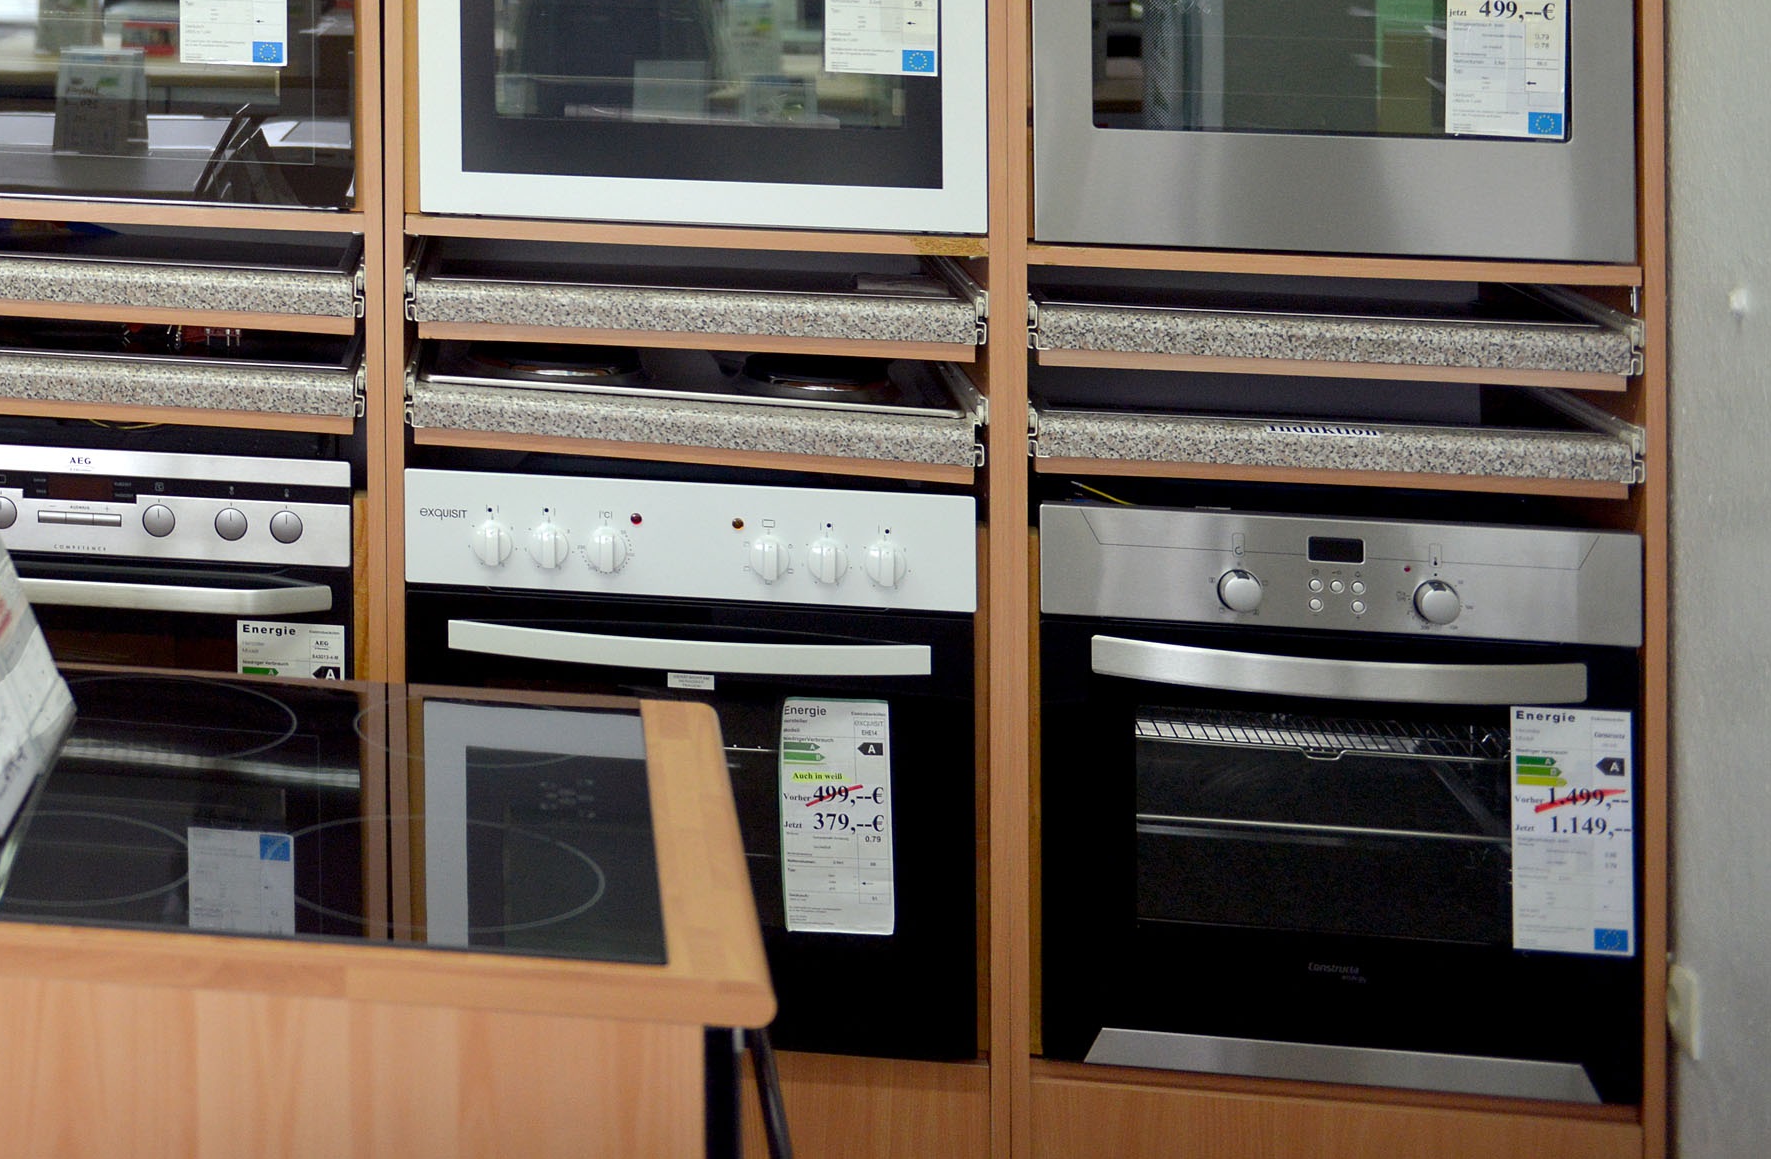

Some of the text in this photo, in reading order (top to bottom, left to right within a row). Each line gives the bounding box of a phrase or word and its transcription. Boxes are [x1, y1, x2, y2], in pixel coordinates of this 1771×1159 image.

[1449, 0, 1556, 22] jetzt 499,--€
[242, 624, 296, 636] Energie
[784, 706, 827, 718] Energie
[1516, 710, 1576, 723] Energie
[867, 744, 876, 754] A
[1610, 762, 1620, 772] A
[792, 772, 843, 780] Auch in weiß
[783, 786, 884, 807] Vorher 499,--€
[1514, 788, 1629, 810] Vorher 1.499,--
[784, 812, 884, 834] Jetzt 379,--€
[1515, 816, 1632, 838] Jetzt 1.149,--
[865, 835, 882, 844] 0.79
[1308, 962, 1360, 974] Constructa
